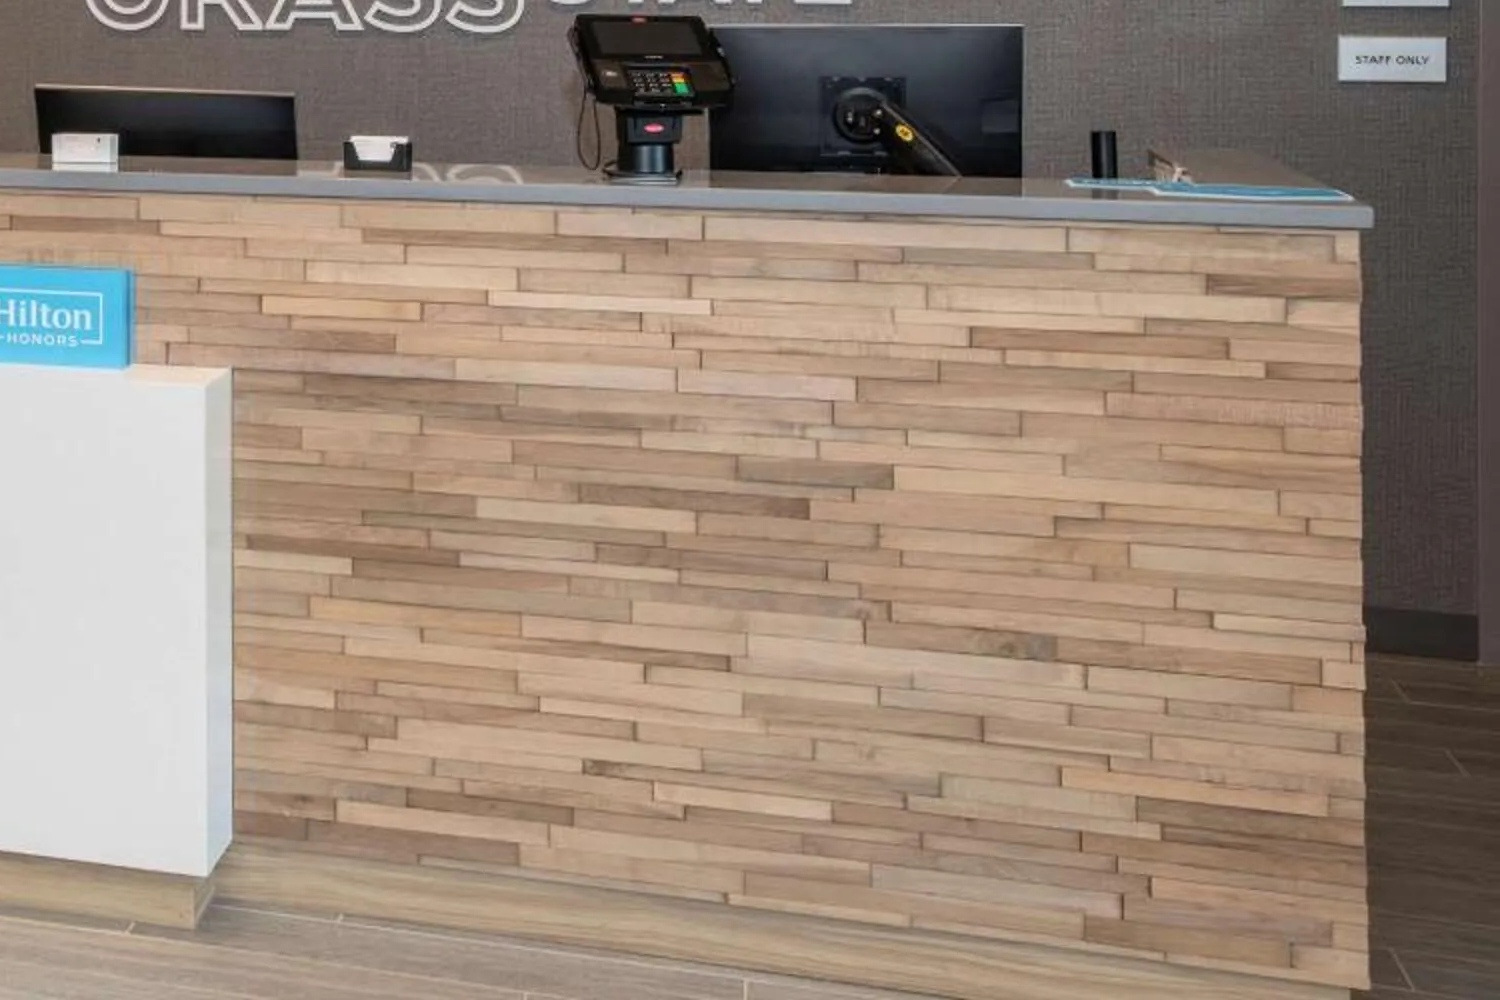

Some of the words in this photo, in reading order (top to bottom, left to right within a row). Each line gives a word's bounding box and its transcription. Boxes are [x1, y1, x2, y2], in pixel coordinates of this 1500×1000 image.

[1355, 55, 1392, 65] STAFF
[1395, 55, 1431, 65] ONLY
[7, 333, 80, 347] HONORS
